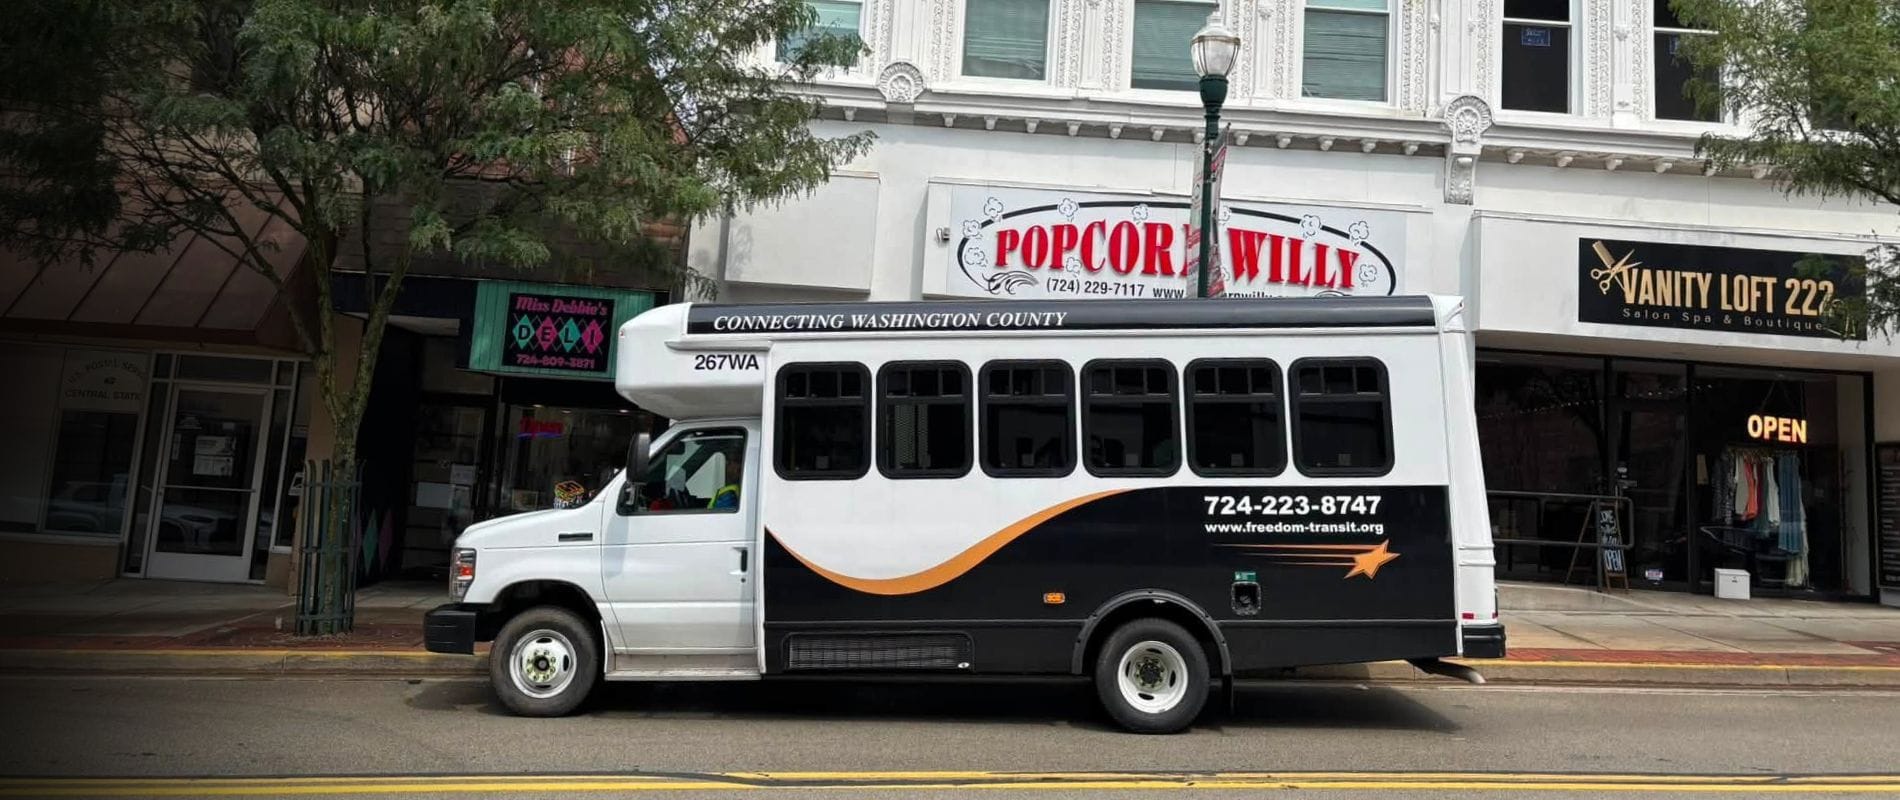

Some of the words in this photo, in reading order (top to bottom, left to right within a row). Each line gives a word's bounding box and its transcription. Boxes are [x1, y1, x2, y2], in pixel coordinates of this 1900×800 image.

[1227, 228, 1359, 288] WILLY
[1046, 277, 1080, 295] (724)
[1084, 281, 1145, 297] 229-7117
[1620, 267, 1712, 309] VANITY
[1720, 273, 1777, 313] LOFT
[1785, 278, 1834, 316] 222
[515, 296, 551, 312] Miss
[552, 298, 607, 315] Debbie's
[713, 314, 845, 330] CONNECTING
[851, 312, 981, 329] WASHINGTON
[986, 312, 1067, 327] COUNTY
[1622, 308, 1670, 320] Salon
[1682, 312, 1711, 325] Spa
[1723, 315, 1732, 325] &
[1744, 317, 1823, 332] Boutique
[518, 325, 596, 343] DELI
[695, 354, 759, 370] 267WA
[1747, 414, 1807, 444] OPEN
[1204, 496, 1381, 515] 724-223-8747
[1205, 521, 1384, 535] www.freedom-transit.org
